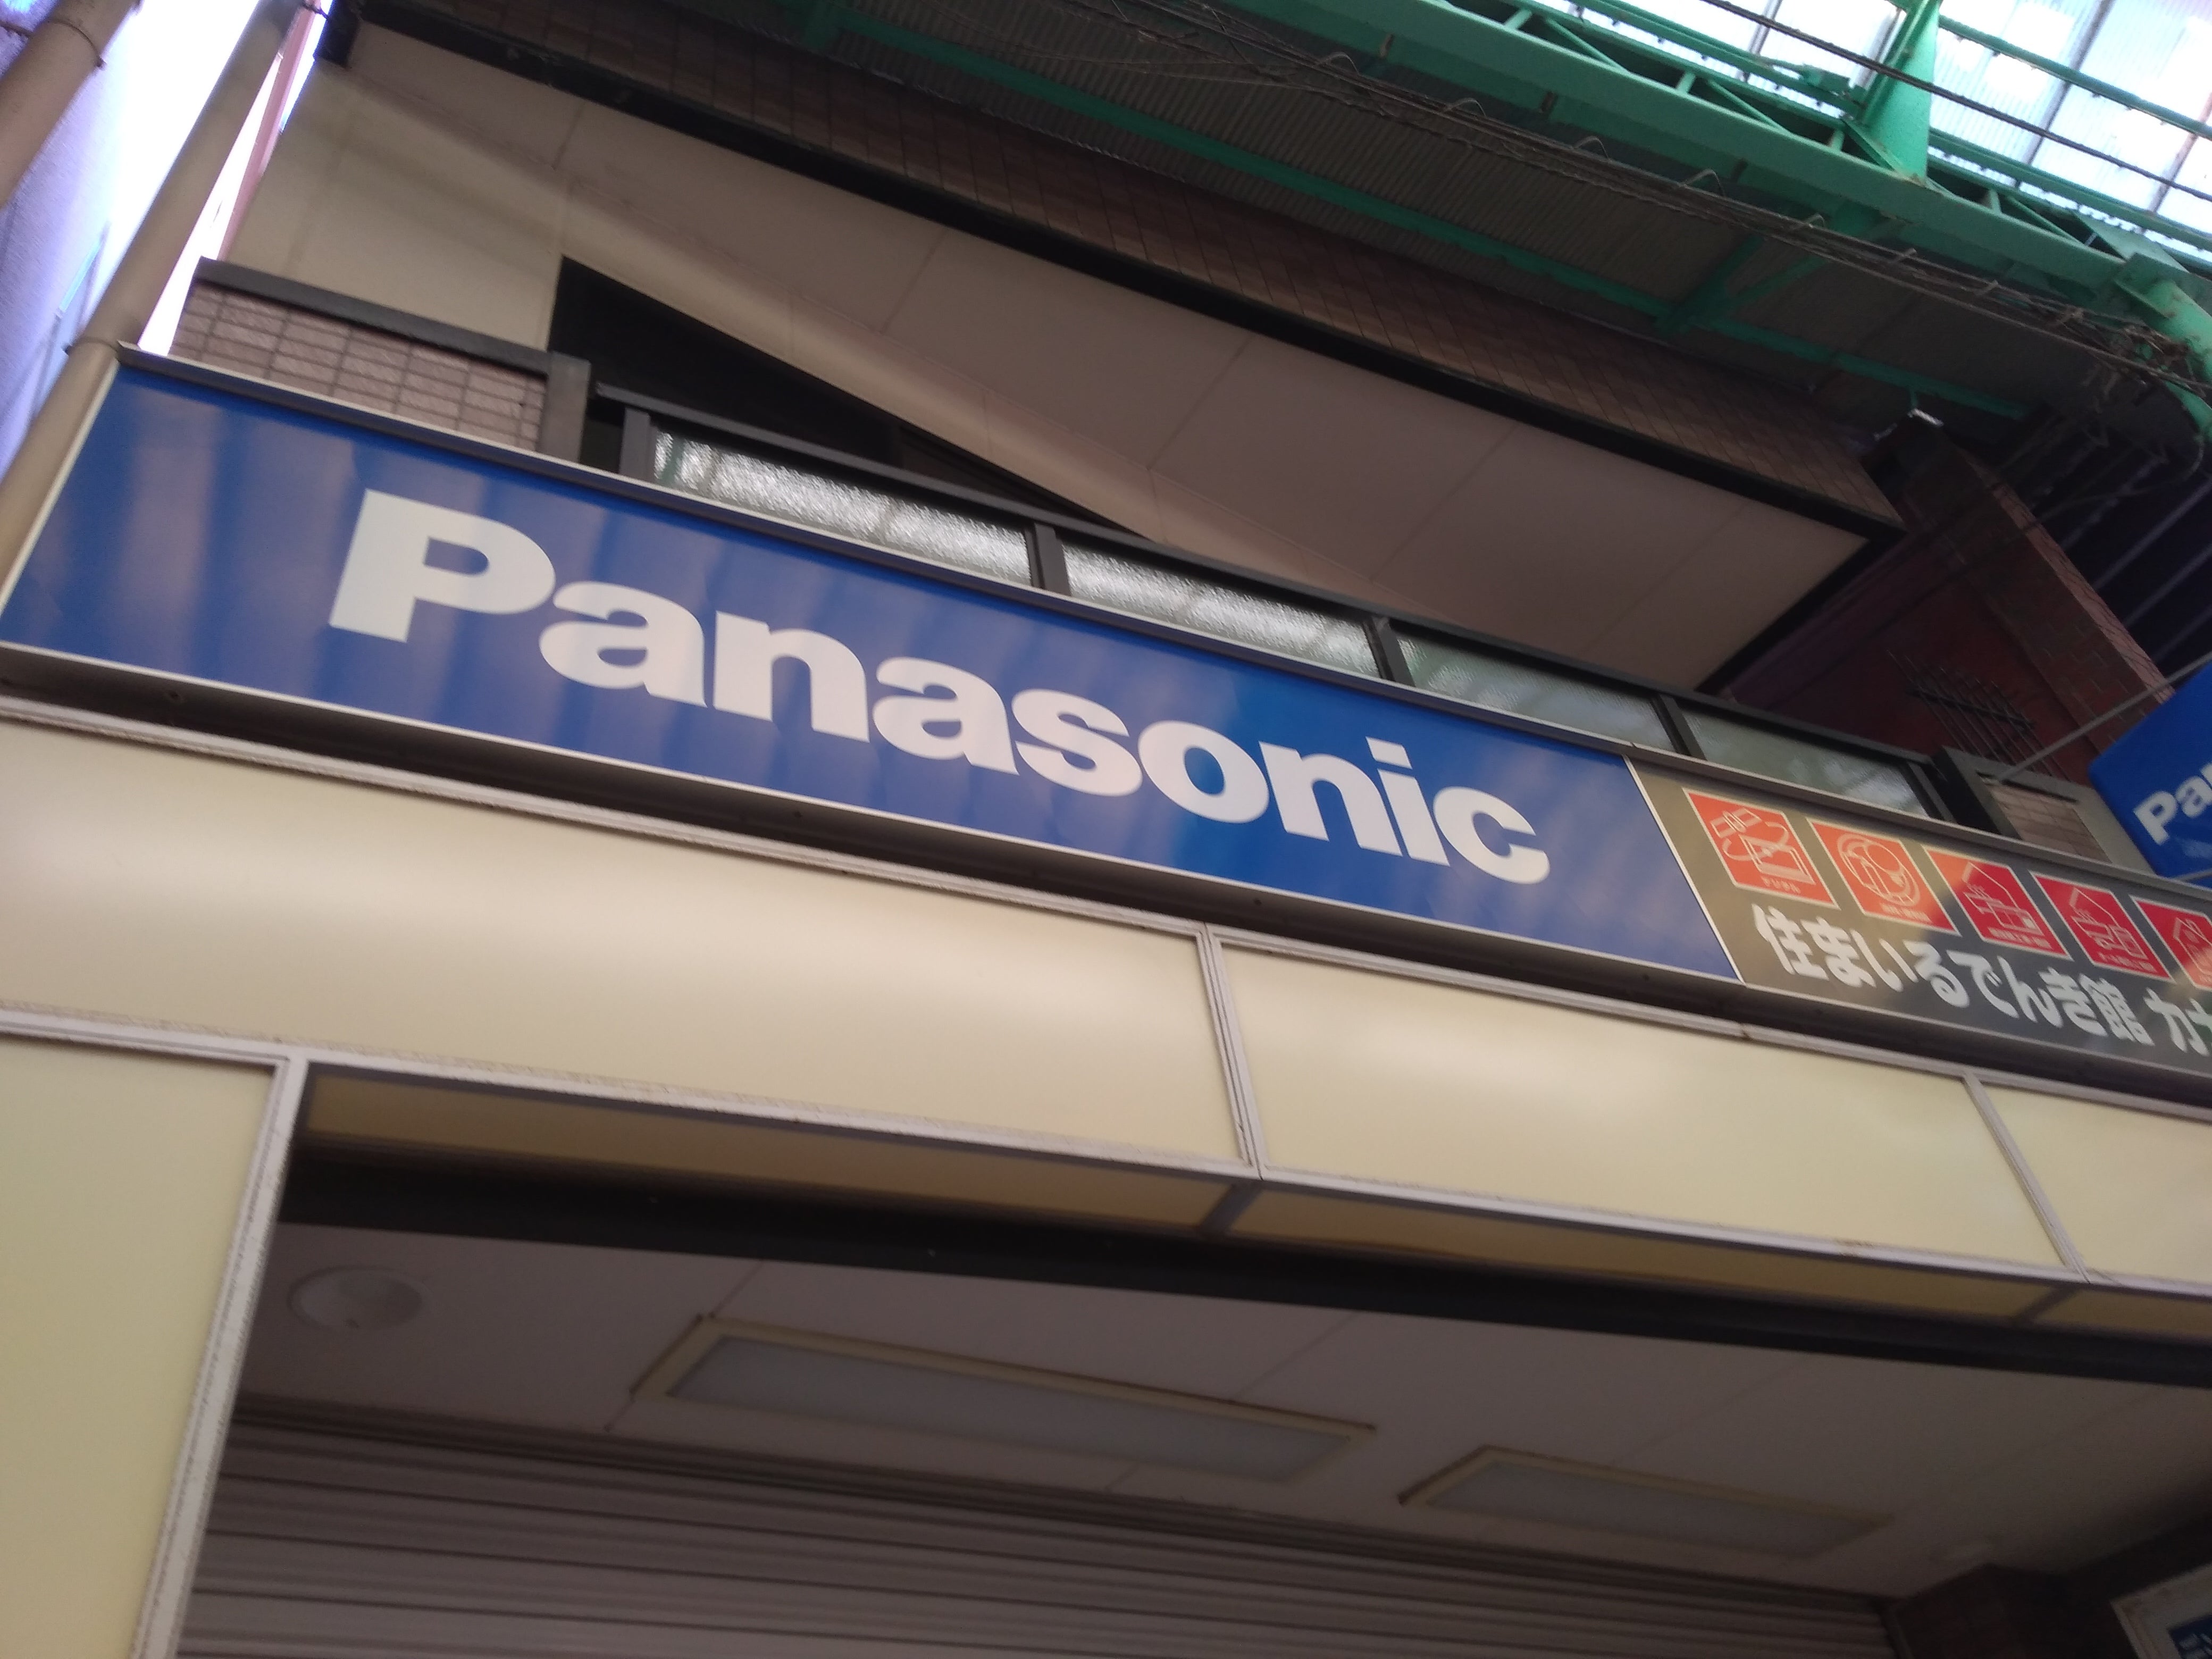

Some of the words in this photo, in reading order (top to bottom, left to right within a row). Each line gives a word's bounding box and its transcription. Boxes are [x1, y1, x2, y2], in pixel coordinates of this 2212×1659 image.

[328, 489, 1551, 885] Panasonic
[2133, 762, 2212, 846] Pa
[1752, 903, 2155, 1046] 住まいるでんき館
